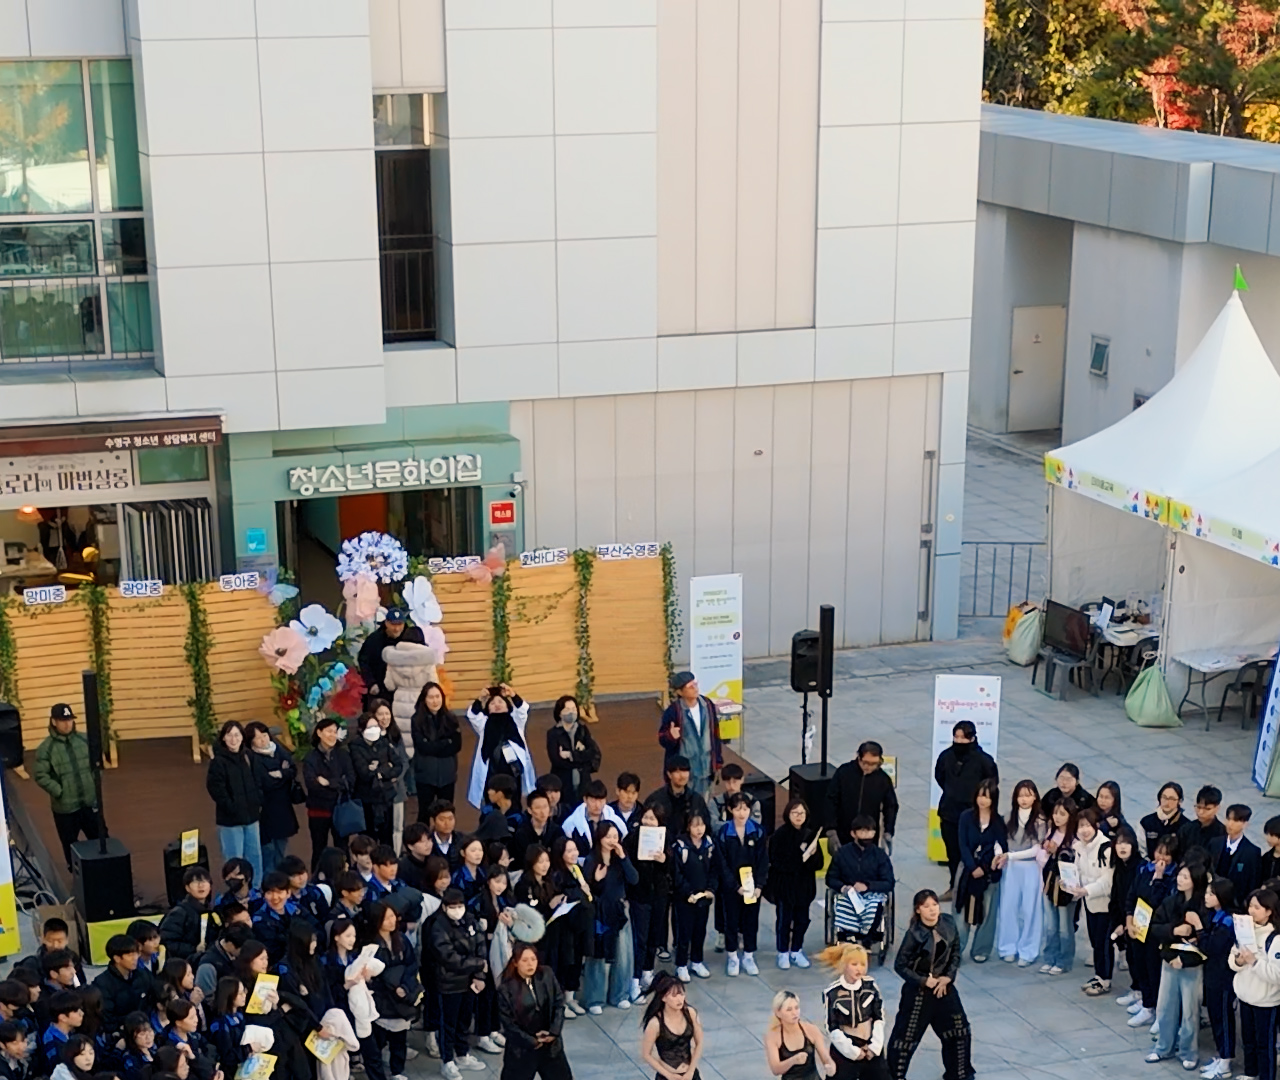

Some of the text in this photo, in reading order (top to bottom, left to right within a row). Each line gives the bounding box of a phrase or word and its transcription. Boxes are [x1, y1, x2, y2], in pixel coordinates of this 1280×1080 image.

[105, 431, 216, 448] 수영구 청소년 상담복지 센터
[57, 468, 129, 491] 마법살롱
[289, 454, 482, 496] 청소년문화의집
[598, 543, 658, 558] 부산수영중
[122, 581, 162, 597] 광안중
[222, 574, 259, 590] 동아중
[25, 588, 65, 604] 망미중
